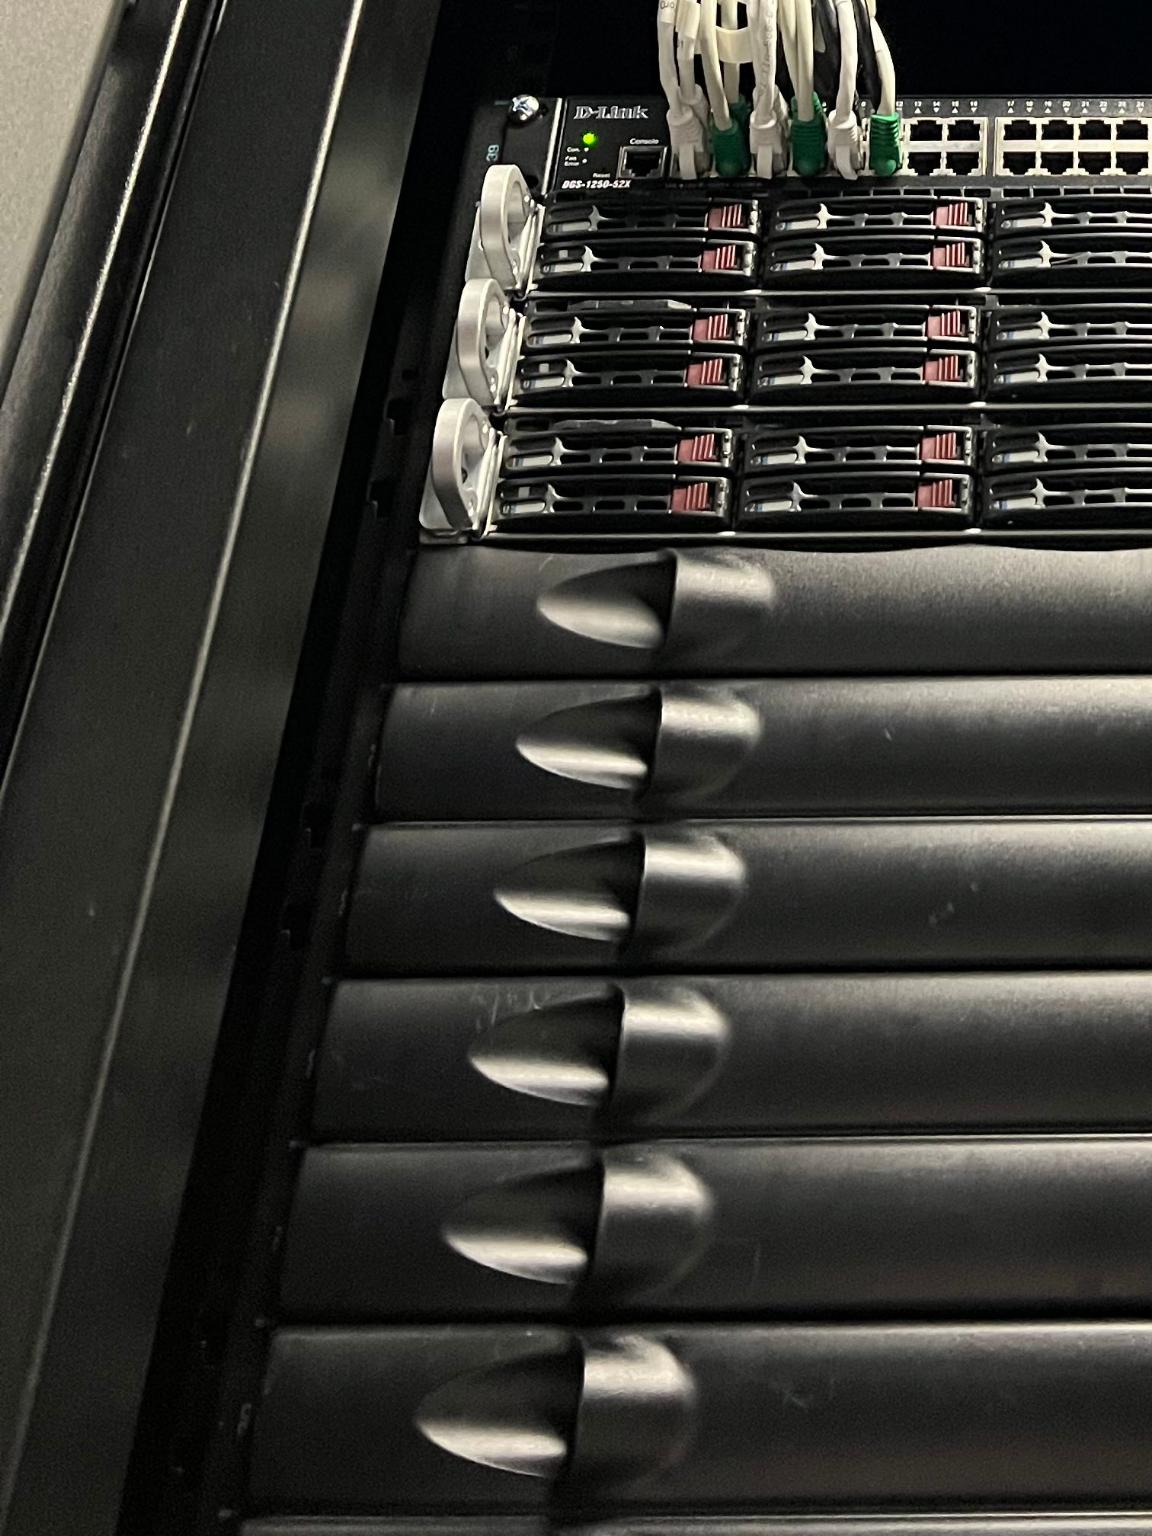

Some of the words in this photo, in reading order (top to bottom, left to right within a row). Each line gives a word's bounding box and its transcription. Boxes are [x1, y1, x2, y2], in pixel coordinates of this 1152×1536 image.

[573, 105, 648, 119] D-Link
[486, 144, 499, 161] 39
[561, 180, 632, 189] DGS-1250-52X
